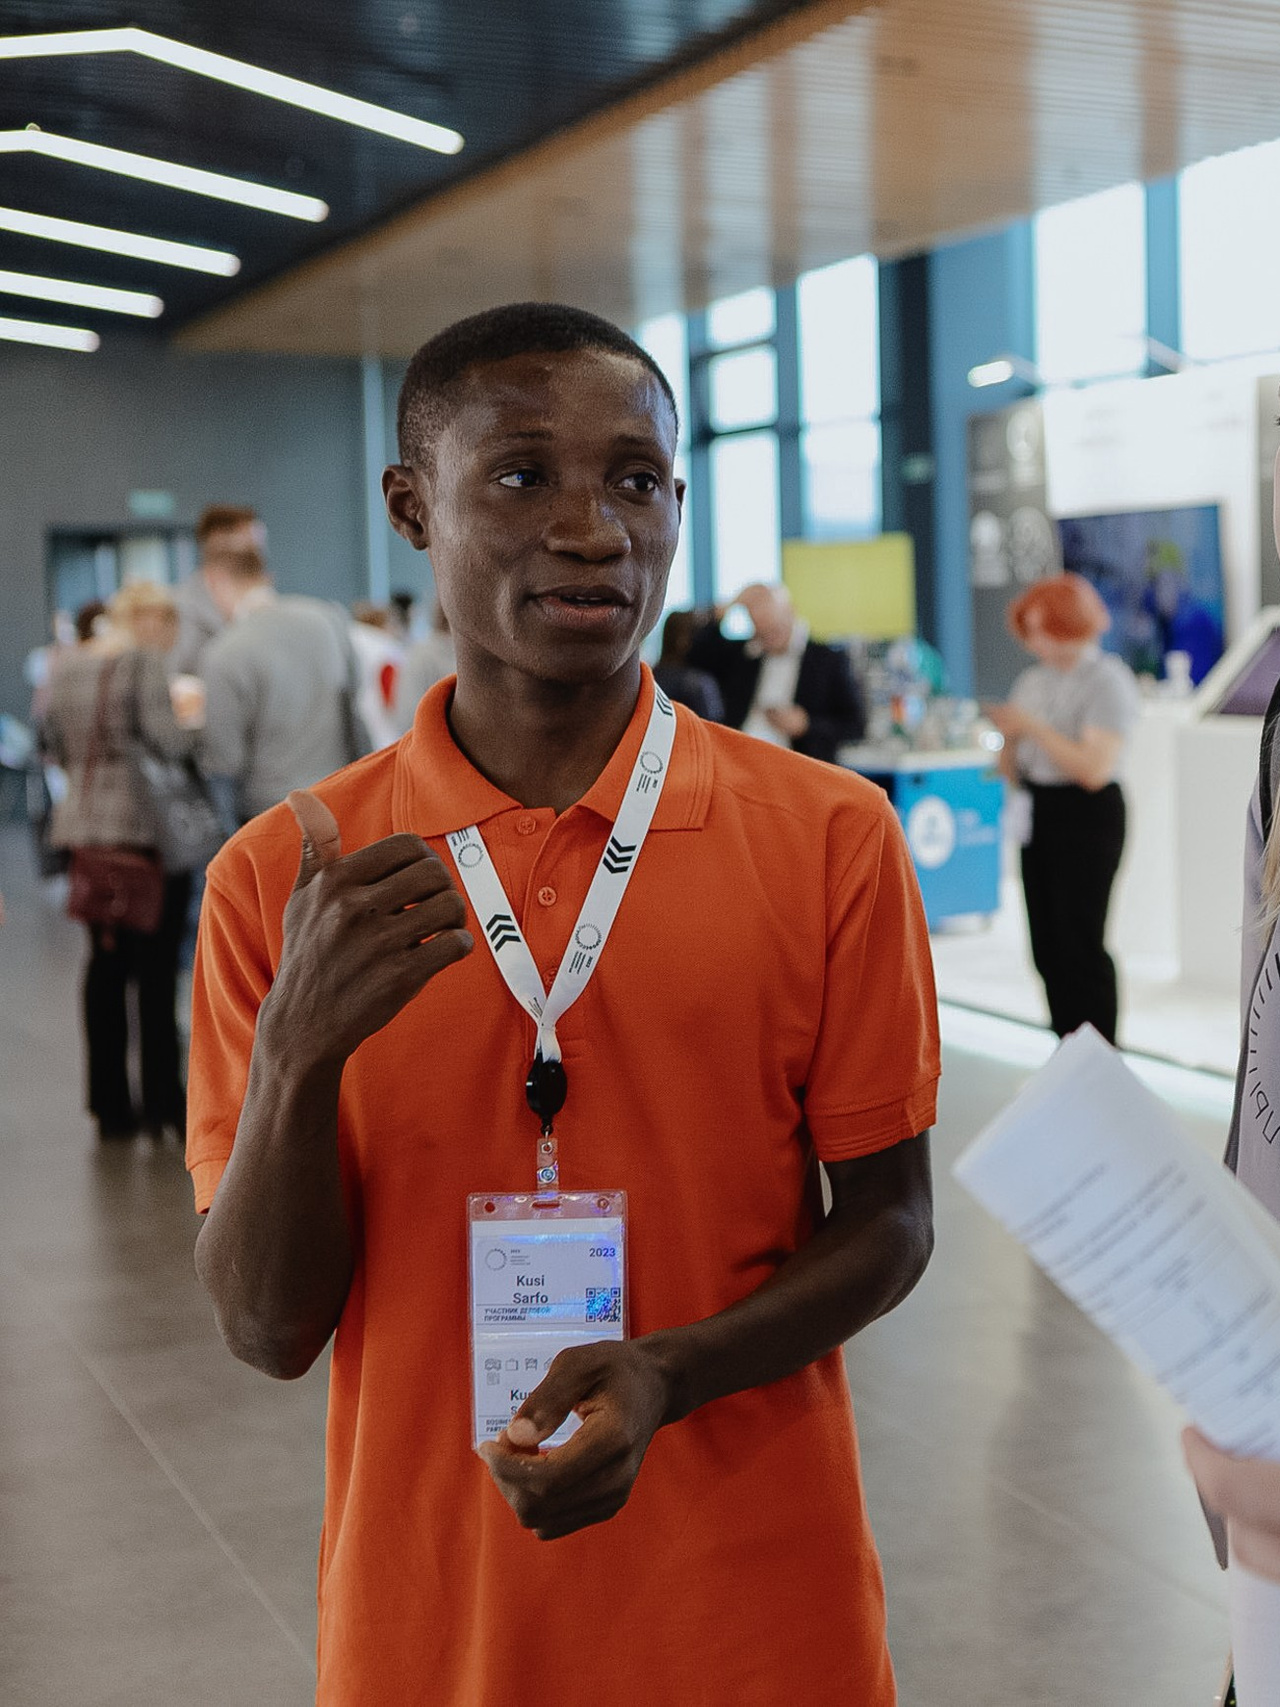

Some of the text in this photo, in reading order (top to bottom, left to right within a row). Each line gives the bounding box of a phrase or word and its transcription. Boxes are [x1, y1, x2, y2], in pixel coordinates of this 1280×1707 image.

[589, 1247, 616, 1258] 2023
[516, 1274, 545, 1287] Kusi
[512, 1291, 549, 1304] Sarfo
